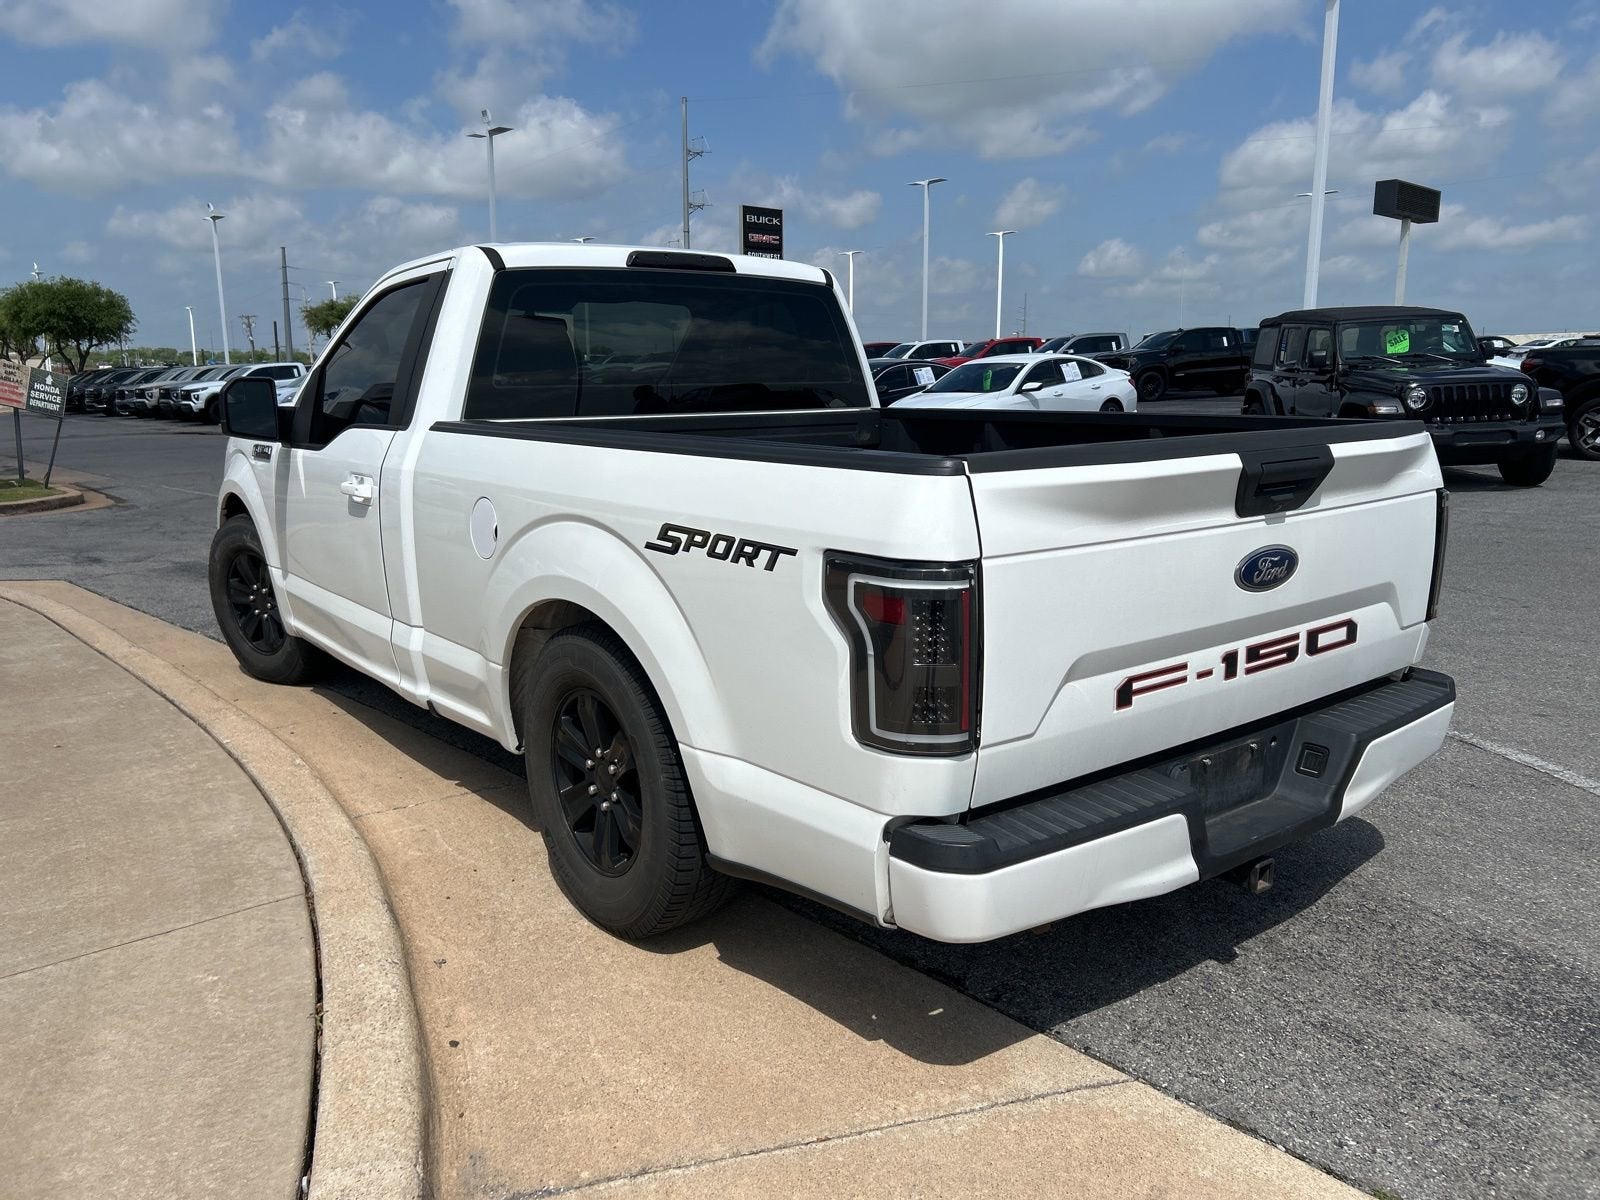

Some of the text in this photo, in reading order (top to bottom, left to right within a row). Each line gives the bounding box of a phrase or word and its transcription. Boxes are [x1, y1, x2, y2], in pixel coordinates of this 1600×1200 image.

[746, 214, 781, 225] BUICK
[748, 233, 780, 244] GMC
[1388, 334, 1407, 347] SALE
[34, 382, 60, 394] HONDA
[30, 390, 62, 404] SERVICE
[29, 398, 60, 411] DEPARTMENT
[644, 522, 799, 572] SPORT
[1253, 555, 1289, 584] Ford
[1114, 617, 1358, 712] F-150
